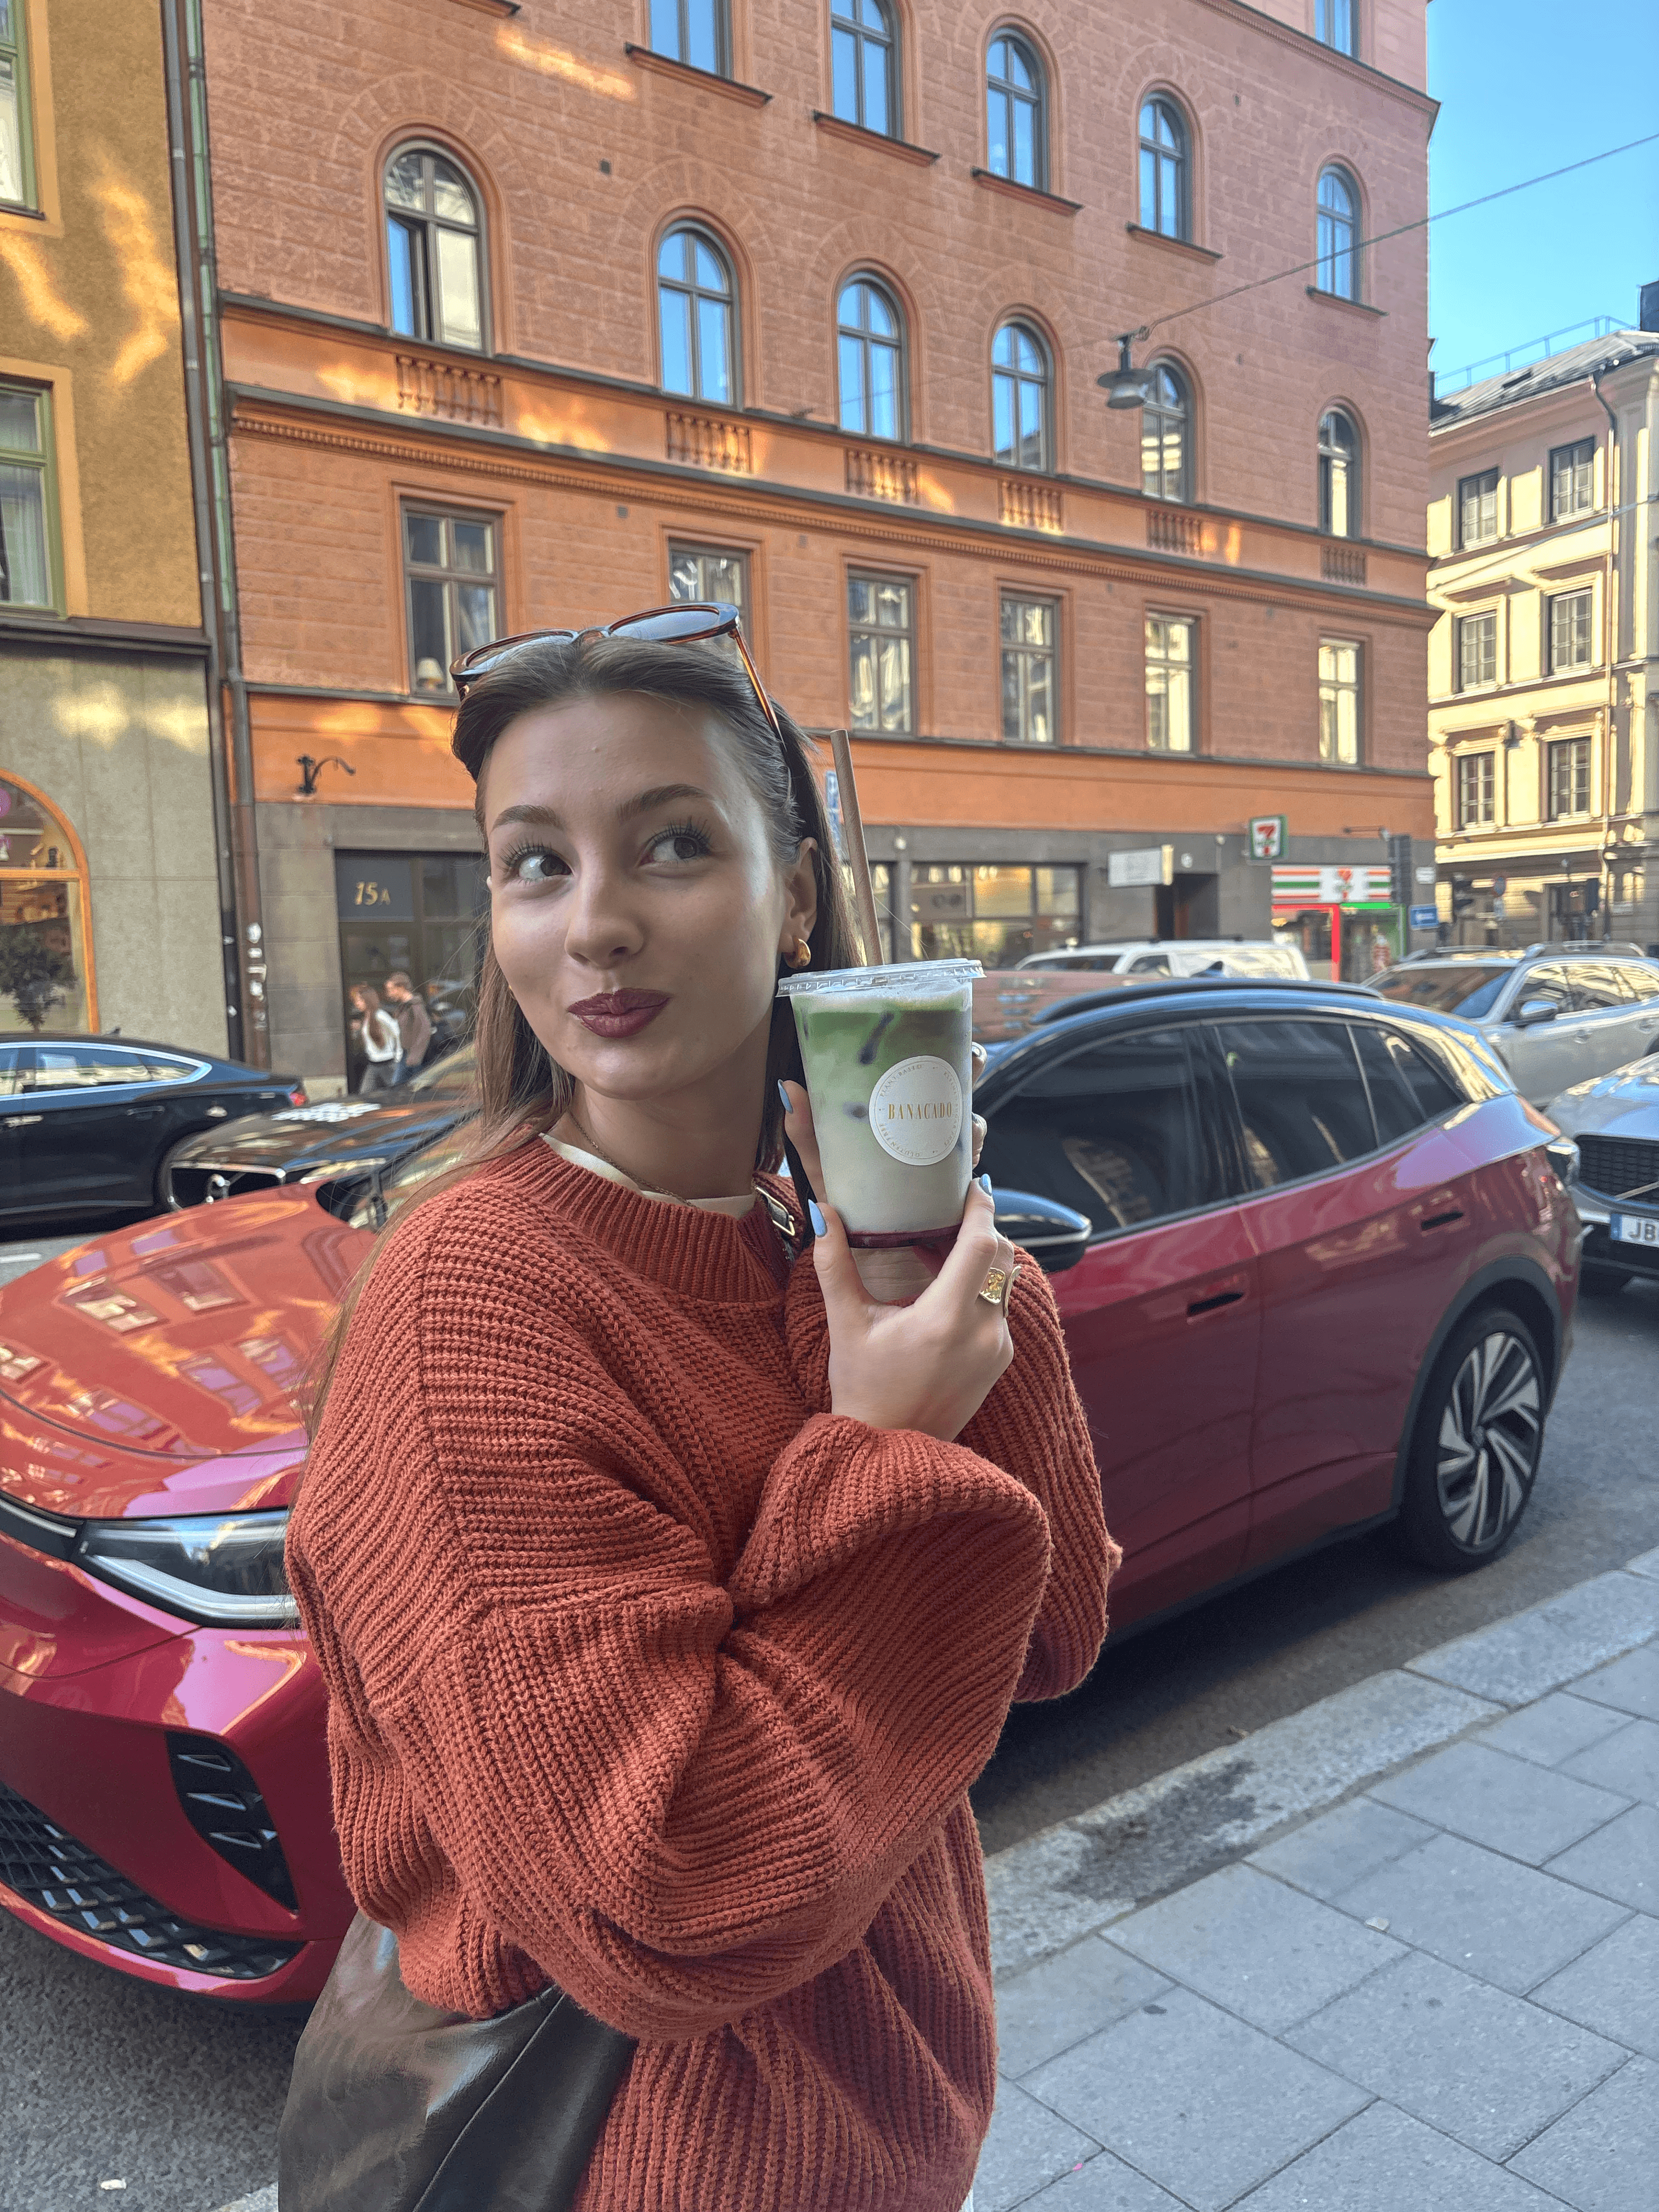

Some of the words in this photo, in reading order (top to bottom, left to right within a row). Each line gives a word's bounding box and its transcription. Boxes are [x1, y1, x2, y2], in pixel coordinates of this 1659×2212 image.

[879, 1075, 896, 1097] PLANT
[898, 1064, 922, 1076] BASED
[888, 1102, 952, 1120] BANACADO
[879, 1123, 892, 1141] FREE
[890, 1141, 920, 1158] GLUTEN
